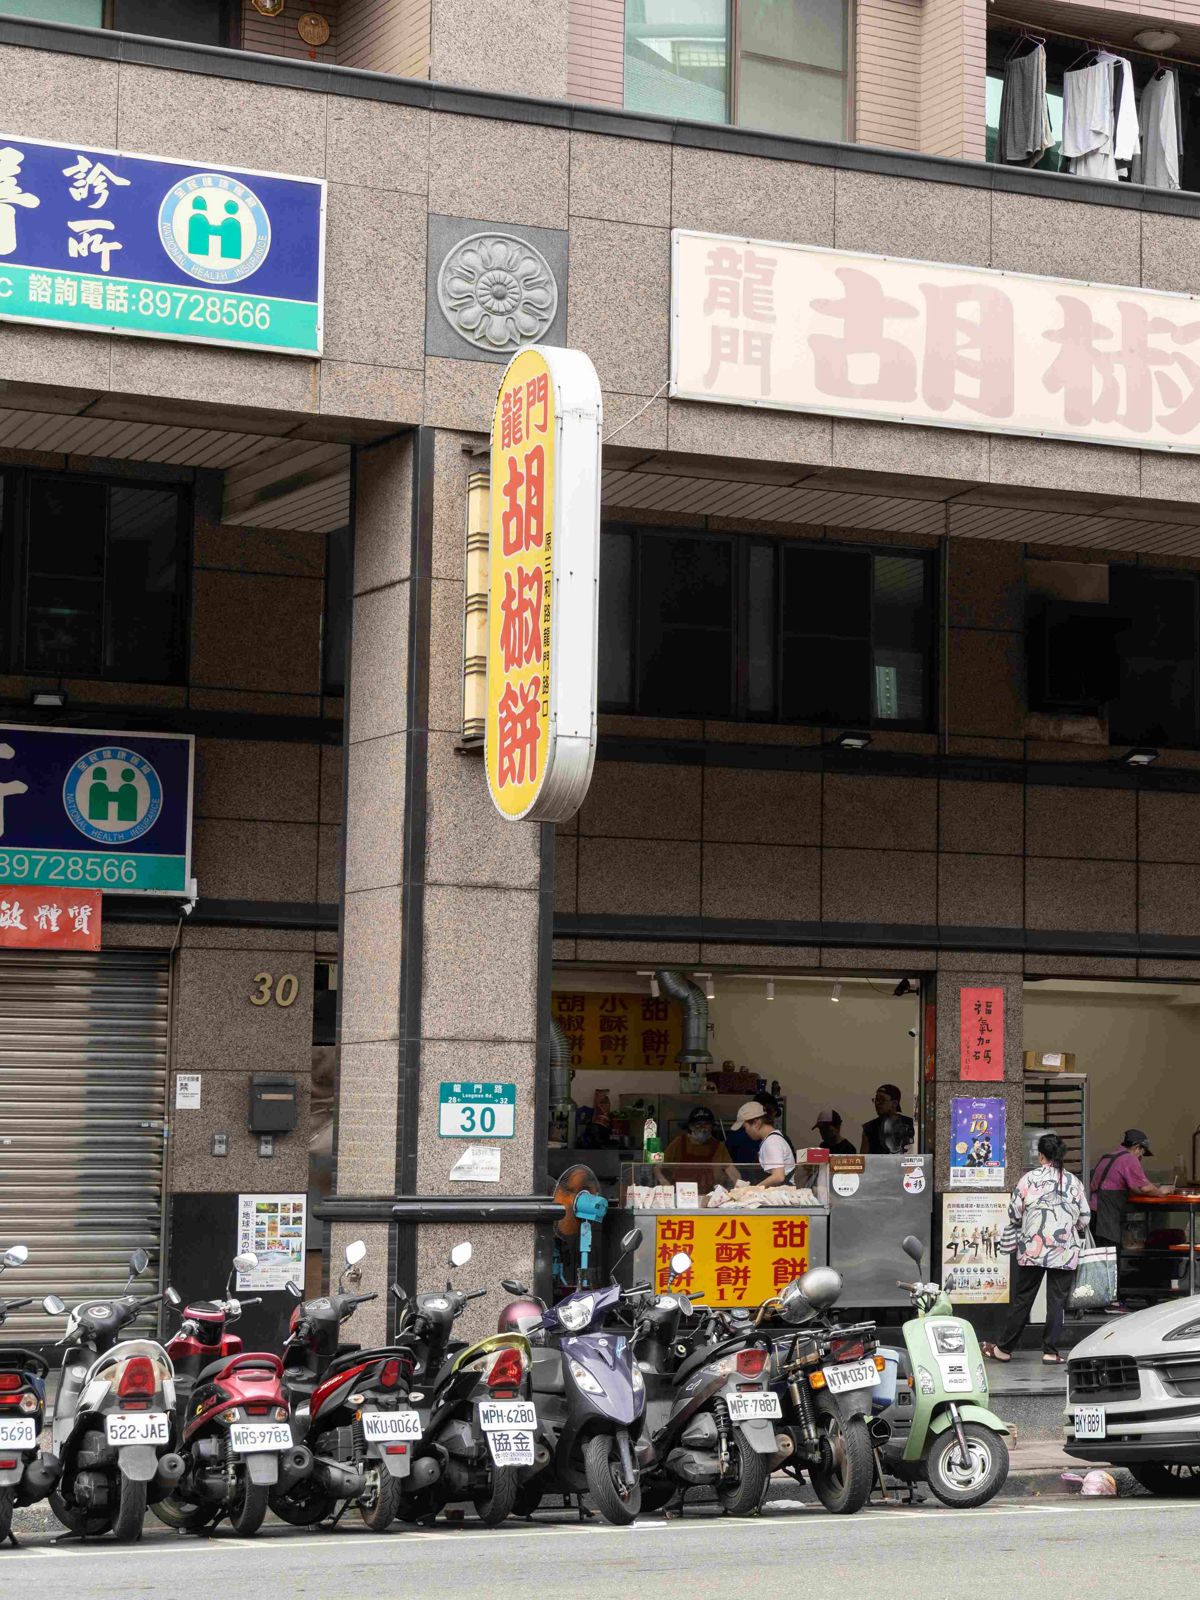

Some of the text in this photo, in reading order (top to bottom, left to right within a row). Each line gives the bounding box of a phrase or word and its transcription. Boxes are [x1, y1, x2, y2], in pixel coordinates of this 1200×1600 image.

[62, 154, 131, 272] 診所
[161, 222, 267, 280] NATIONAL HEALTH INSURANCE
[702, 246, 778, 397] 龍門
[501, 372, 549, 451] 龍門
[497, 443, 546, 790] 胡椒餅
[66, 793, 161, 841] NATIONAL HEALTH INSURANCE
[250, 972, 299, 1008] 30
[453, 1084, 503, 1094] 龍門路
[460, 1106, 496, 1133] 30
[715, 1219, 751, 1287] 小酥餅
[716, 1288, 747, 1301] 17
[828, 1366, 876, 1388] NTM-0379
[482, 1409, 535, 1424] MPH-6280
[730, 1399, 778, 1415] MPF-7887
[110, 1423, 167, 1440] 522-JAE
[365, 1419, 419, 1435] NKU-0066
[492, 1432, 531, 1452] 協金
